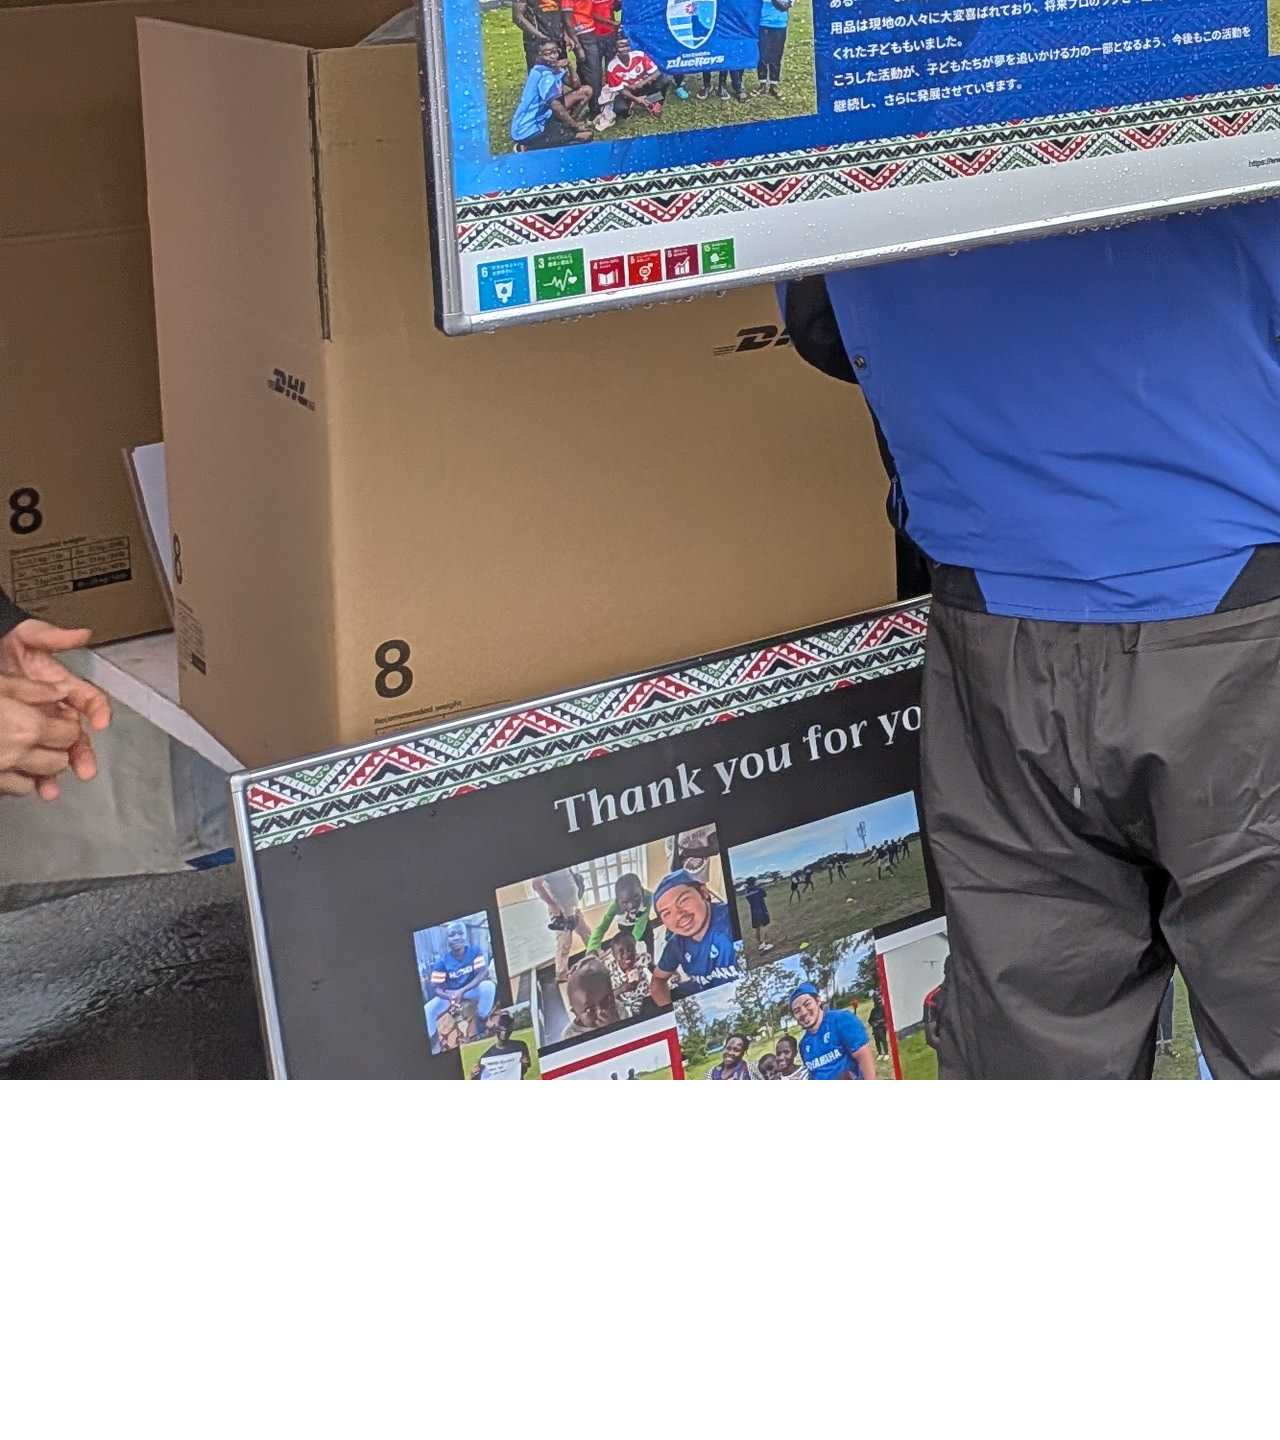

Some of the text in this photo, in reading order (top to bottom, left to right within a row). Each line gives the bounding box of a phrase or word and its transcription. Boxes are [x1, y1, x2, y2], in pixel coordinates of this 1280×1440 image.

[833, 35, 963, 60] くれた子どももいました。
[481, 267, 489, 278] 6
[538, 258, 545, 269] 3
[271, 367, 310, 406] DHL
[9, 487, 42, 535] 8
[173, 532, 183, 585] 8
[375, 639, 413, 699] 8
[554, 760, 705, 834] Thank
[713, 743, 793, 797] you
[800, 718, 870, 763] for
